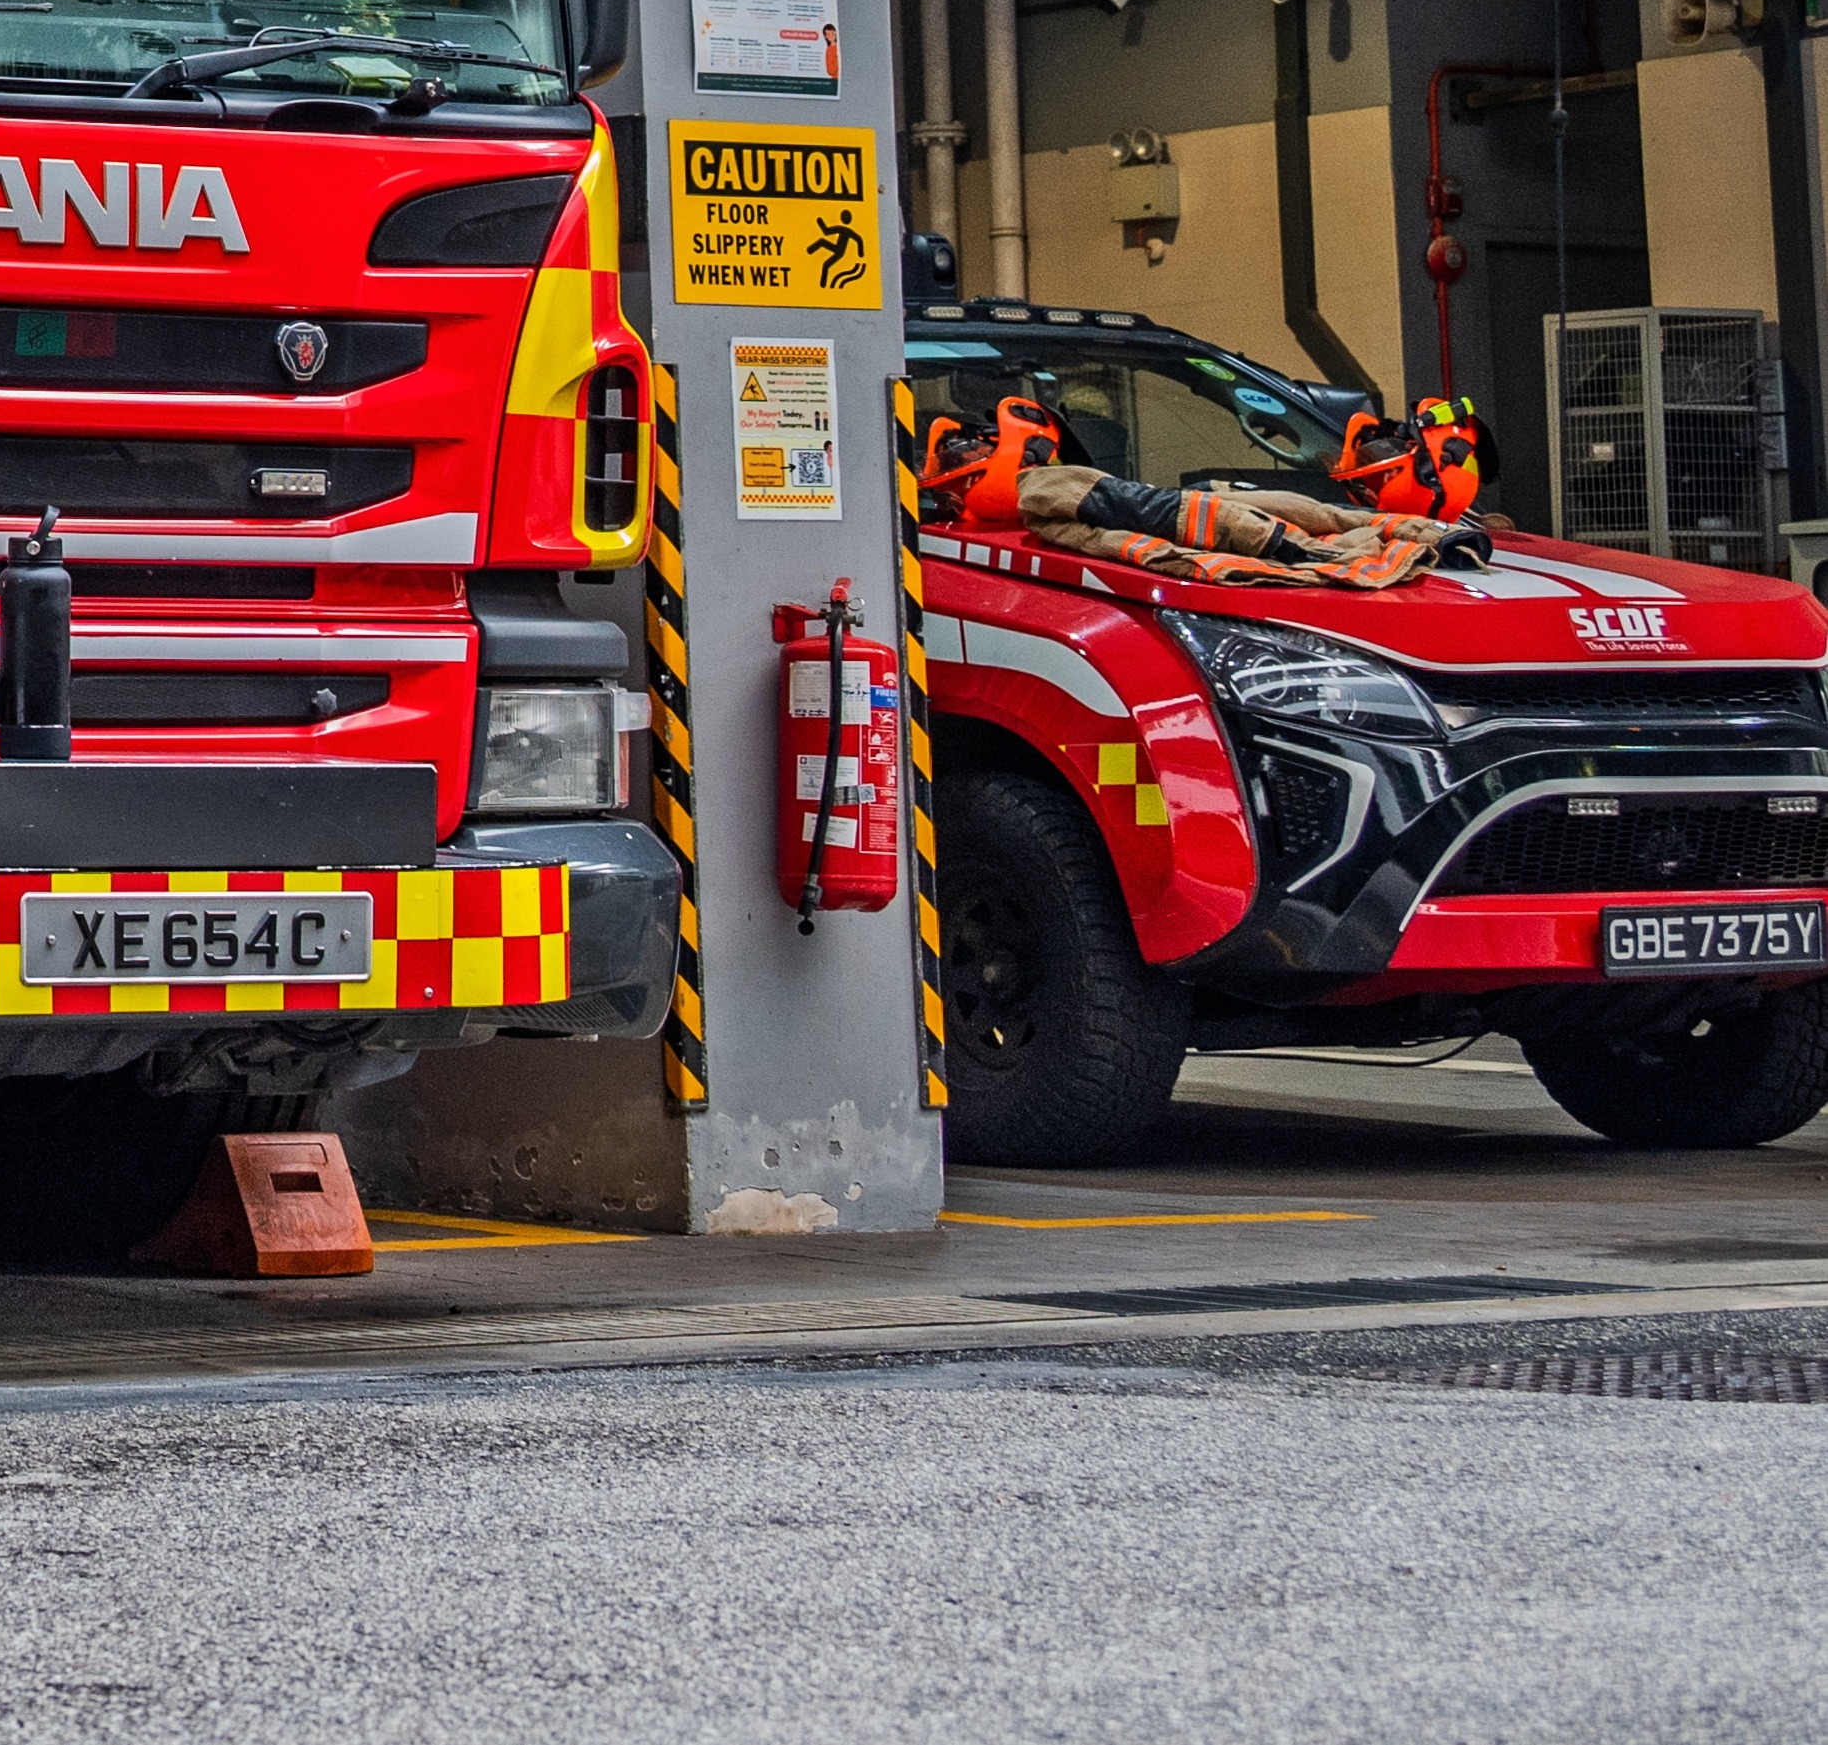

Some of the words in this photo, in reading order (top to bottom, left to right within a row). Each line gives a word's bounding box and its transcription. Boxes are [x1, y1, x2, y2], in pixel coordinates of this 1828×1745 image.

[691, 147, 858, 195] CAUTION
[707, 203, 769, 225] FLOOR
[693, 233, 784, 256] SLIPPERY
[688, 264, 745, 286] WHEN
[750, 266, 791, 287] WET
[736, 356, 780, 365] NEAR-MISS
[782, 357, 827, 366] REPORTING
[755, 420, 776, 430] Safety
[759, 409, 781, 419] Report
[1569, 608, 1667, 637] SCDF
[1585, 641, 1606, 651] The
[1606, 641, 1626, 651] Life
[1625, 642, 1661, 653] Saving
[1658, 641, 1688, 651] Force
[72, 909, 326, 968] XE654C
[1609, 912, 1816, 960] GBE7375Y
